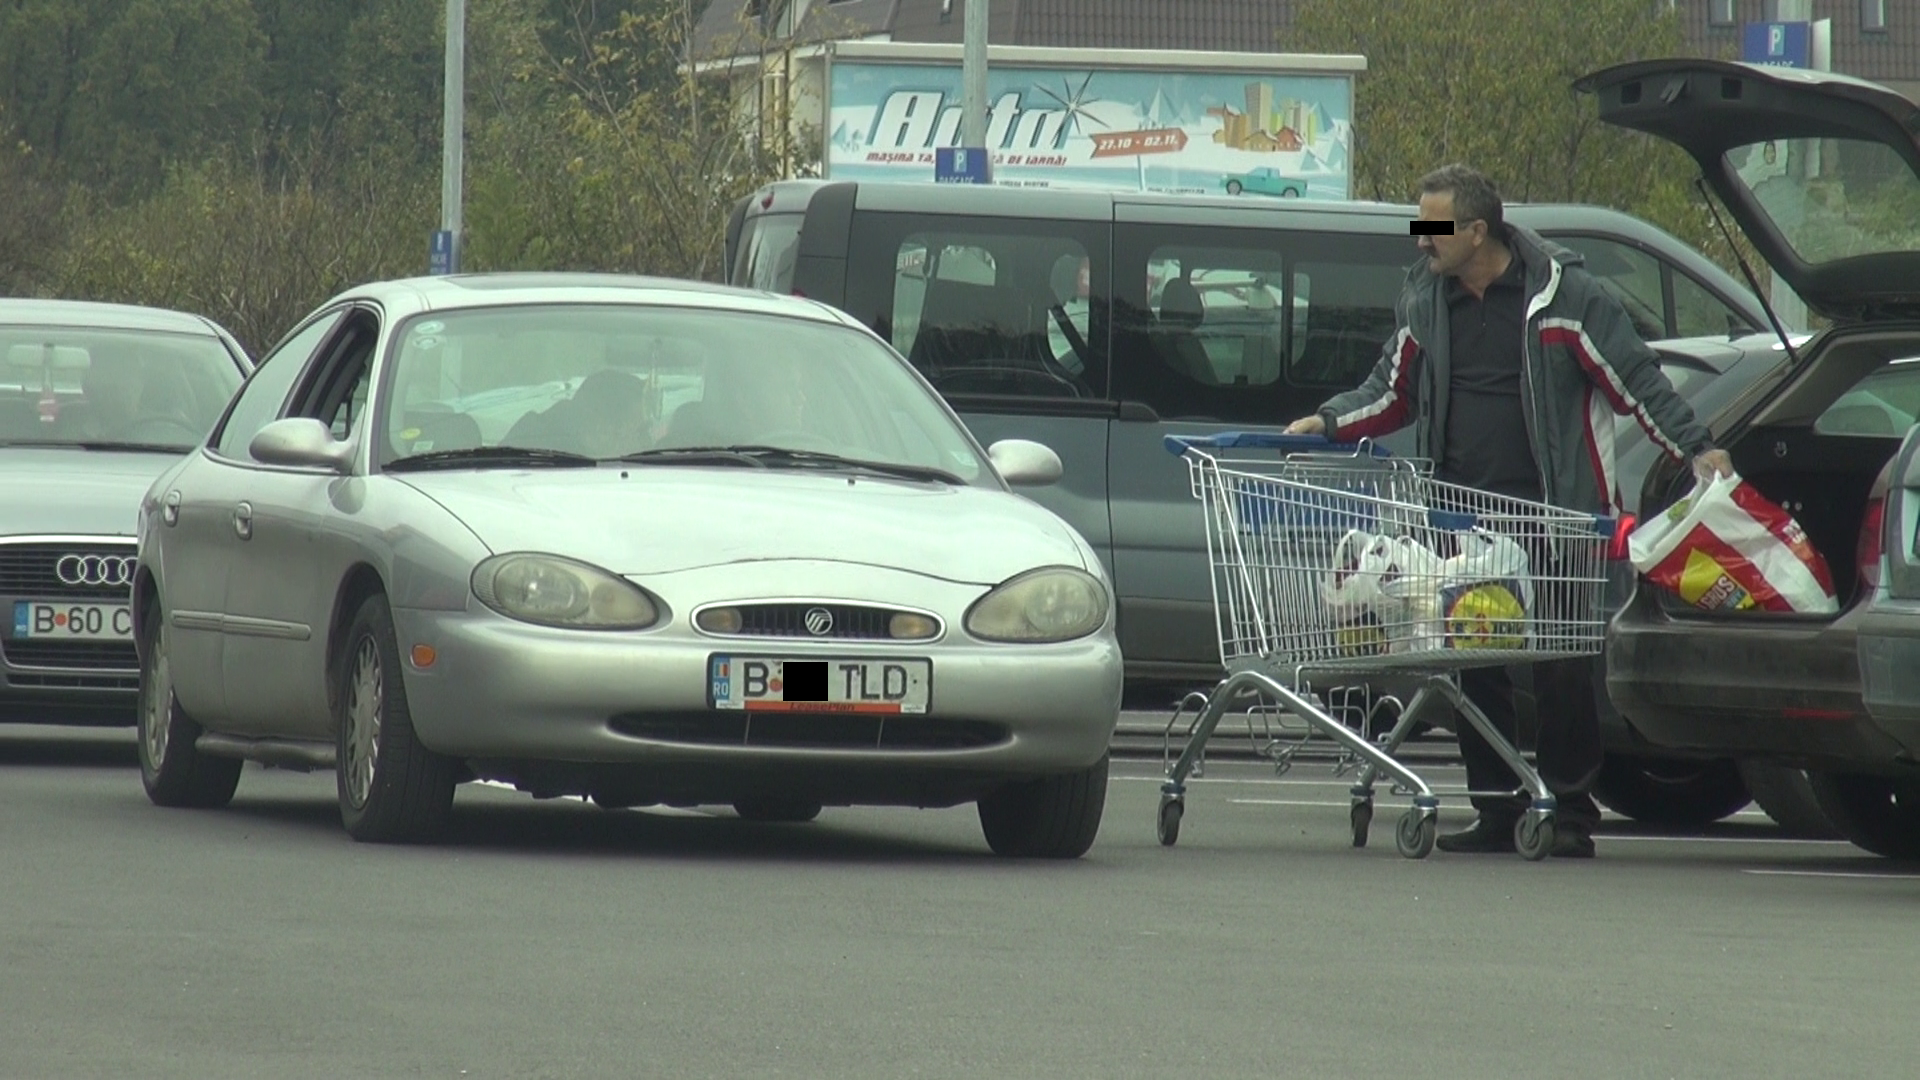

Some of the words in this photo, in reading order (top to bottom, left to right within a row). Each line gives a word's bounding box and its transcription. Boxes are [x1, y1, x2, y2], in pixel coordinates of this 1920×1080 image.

[1099, 138, 1132, 150] 27.10
[743, 661, 770, 698] B
[838, 664, 908, 700] TLD
[713, 682, 729, 697] RO
